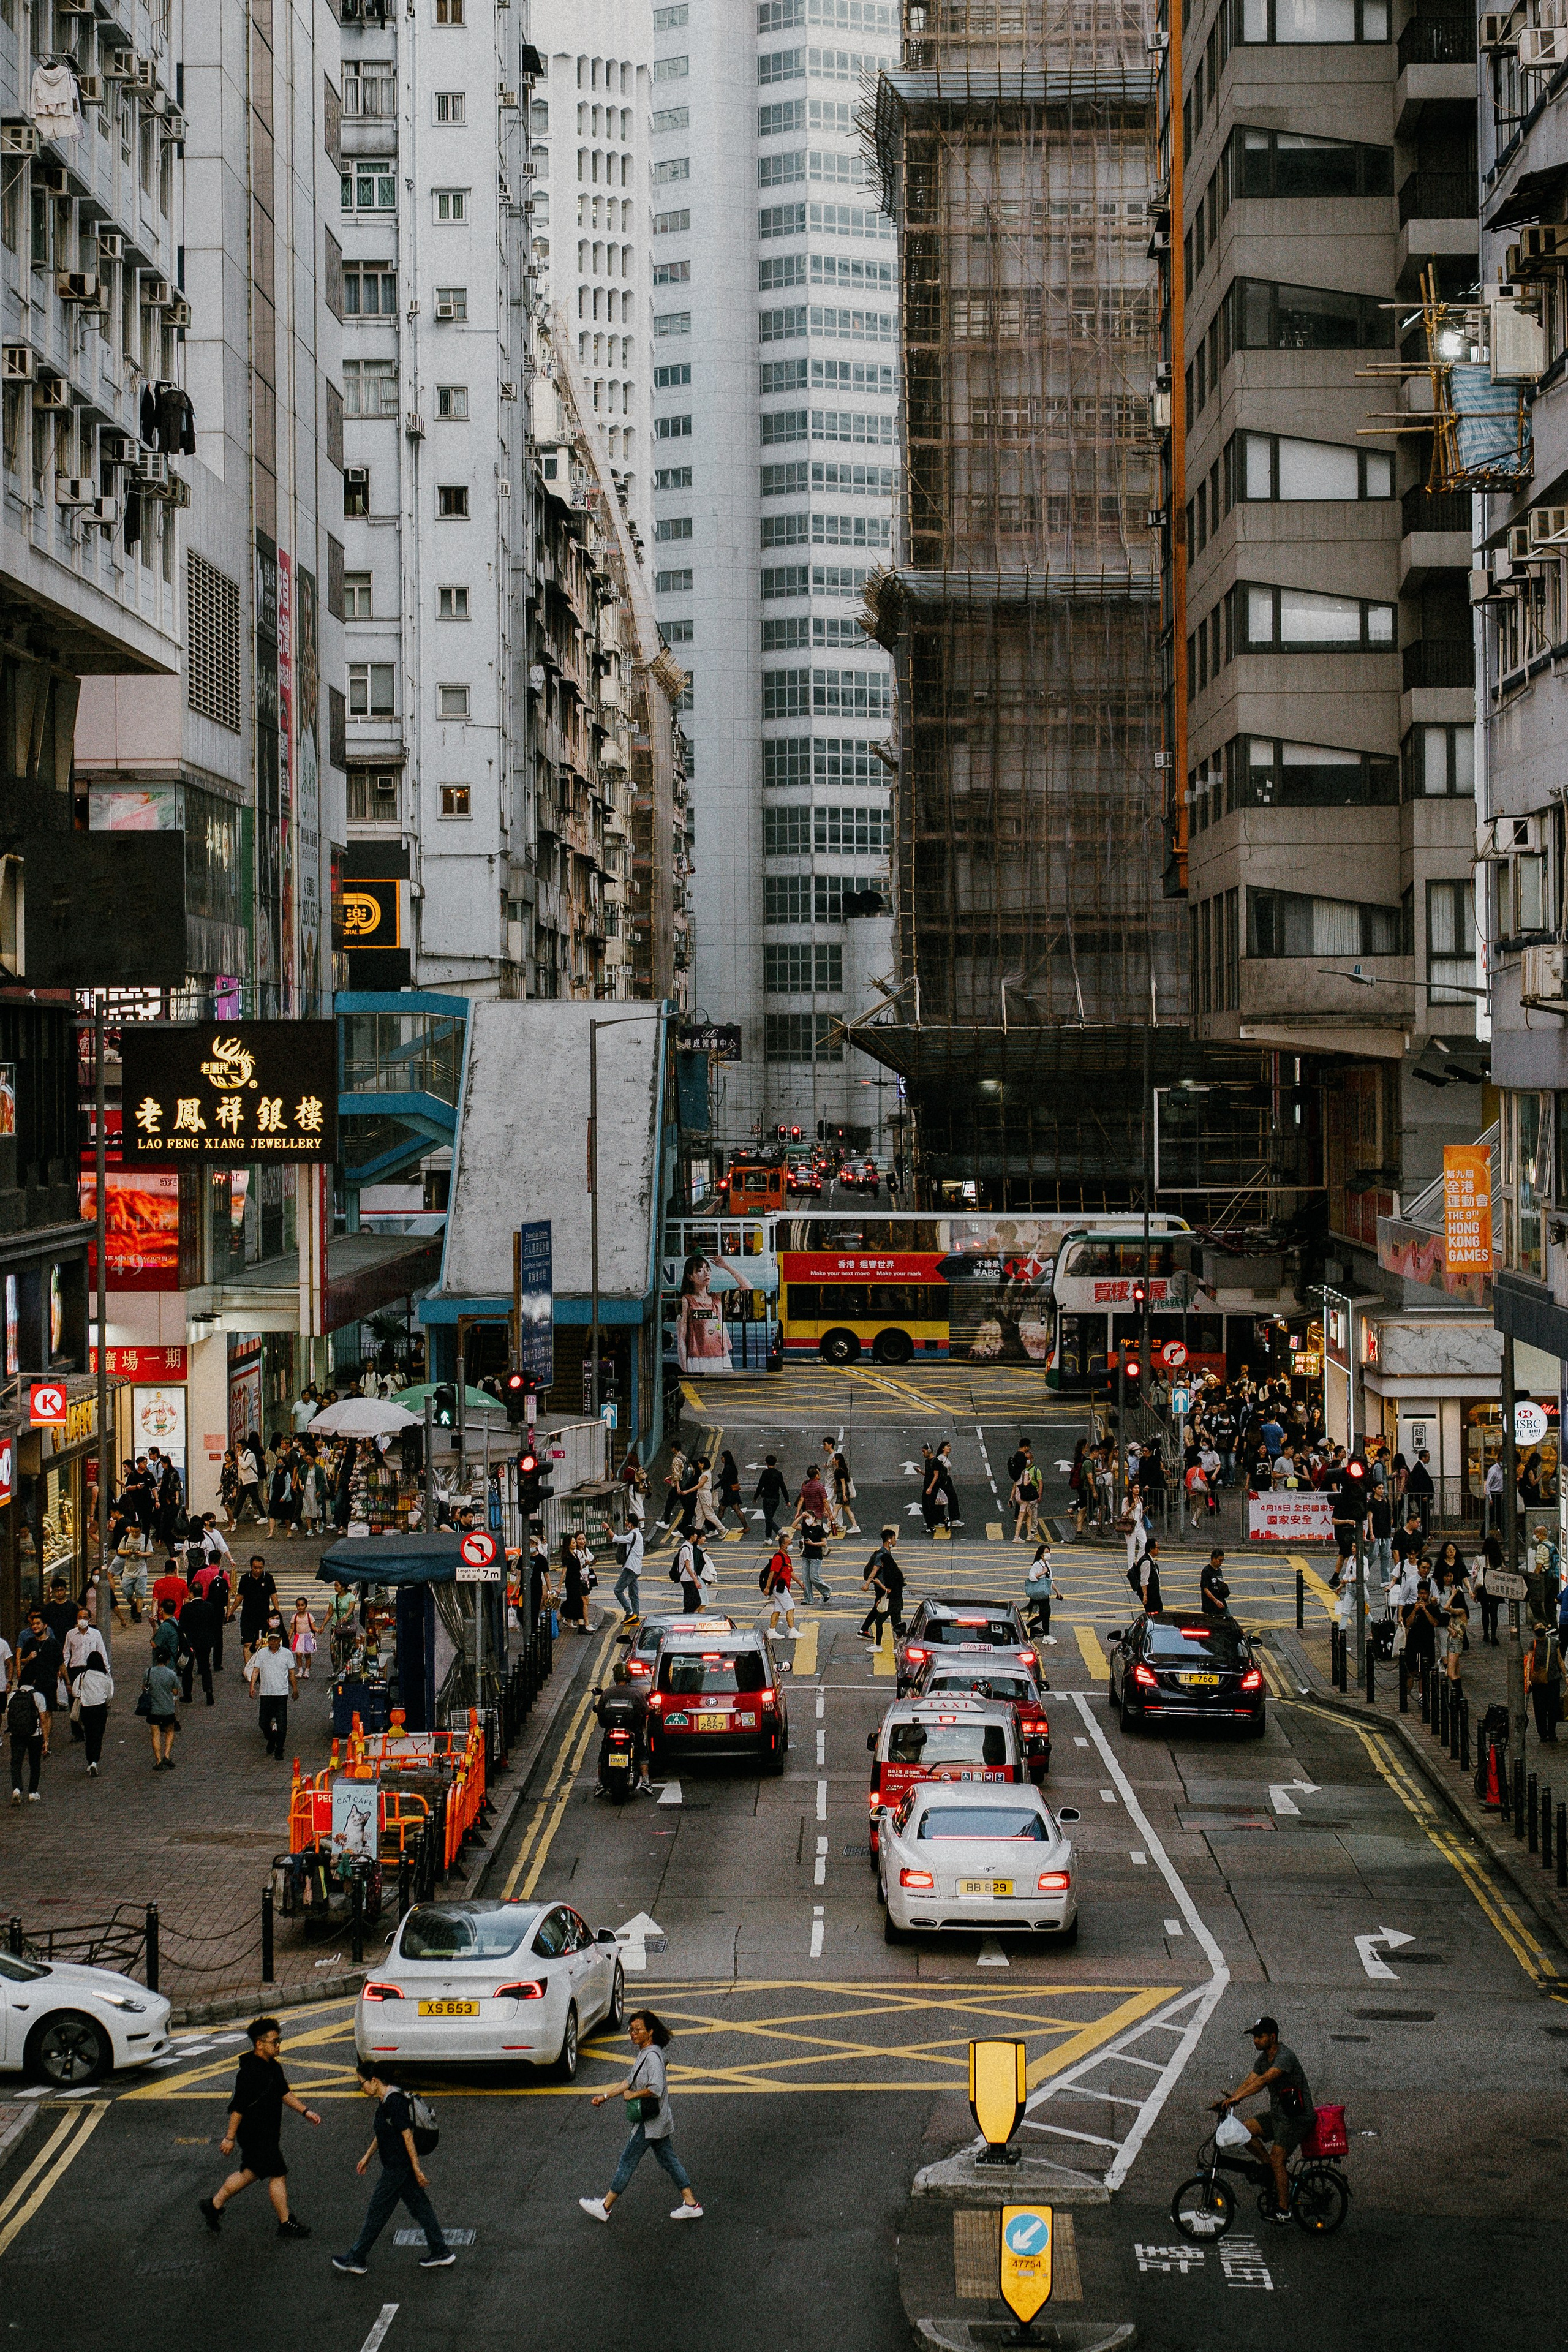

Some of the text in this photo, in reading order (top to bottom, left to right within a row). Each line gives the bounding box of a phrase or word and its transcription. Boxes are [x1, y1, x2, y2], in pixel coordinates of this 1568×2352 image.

[135, 1096, 323, 1135] 老鳳祥銀樓
[137, 1139, 322, 1149] LAO FENG XIANG JEWELLERY
[1447, 1181, 1474, 1193] 全港
[1447, 1194, 1488, 1207] 運動會
[1447, 1210, 1479, 1220] THE 9TH
[1448, 1222, 1480, 1234] HONG
[1448, 1235, 1480, 1248] KONG
[1449, 1250, 1489, 1262] GAMES
[837, 1260, 855, 1268] 香港
[1094, 1281, 1167, 1303] 買樓屋
[1295, 1365, 1316, 1373] 果汁
[42, 1395, 56, 1409] K
[1515, 1419, 1541, 1429] HSBC
[1267, 1515, 1312, 1525] 國家安全
[353, 1796, 374, 1806] CAFE
[967, 1883, 1007, 1892] BB 829
[427, 2003, 472, 2014] XS 653
